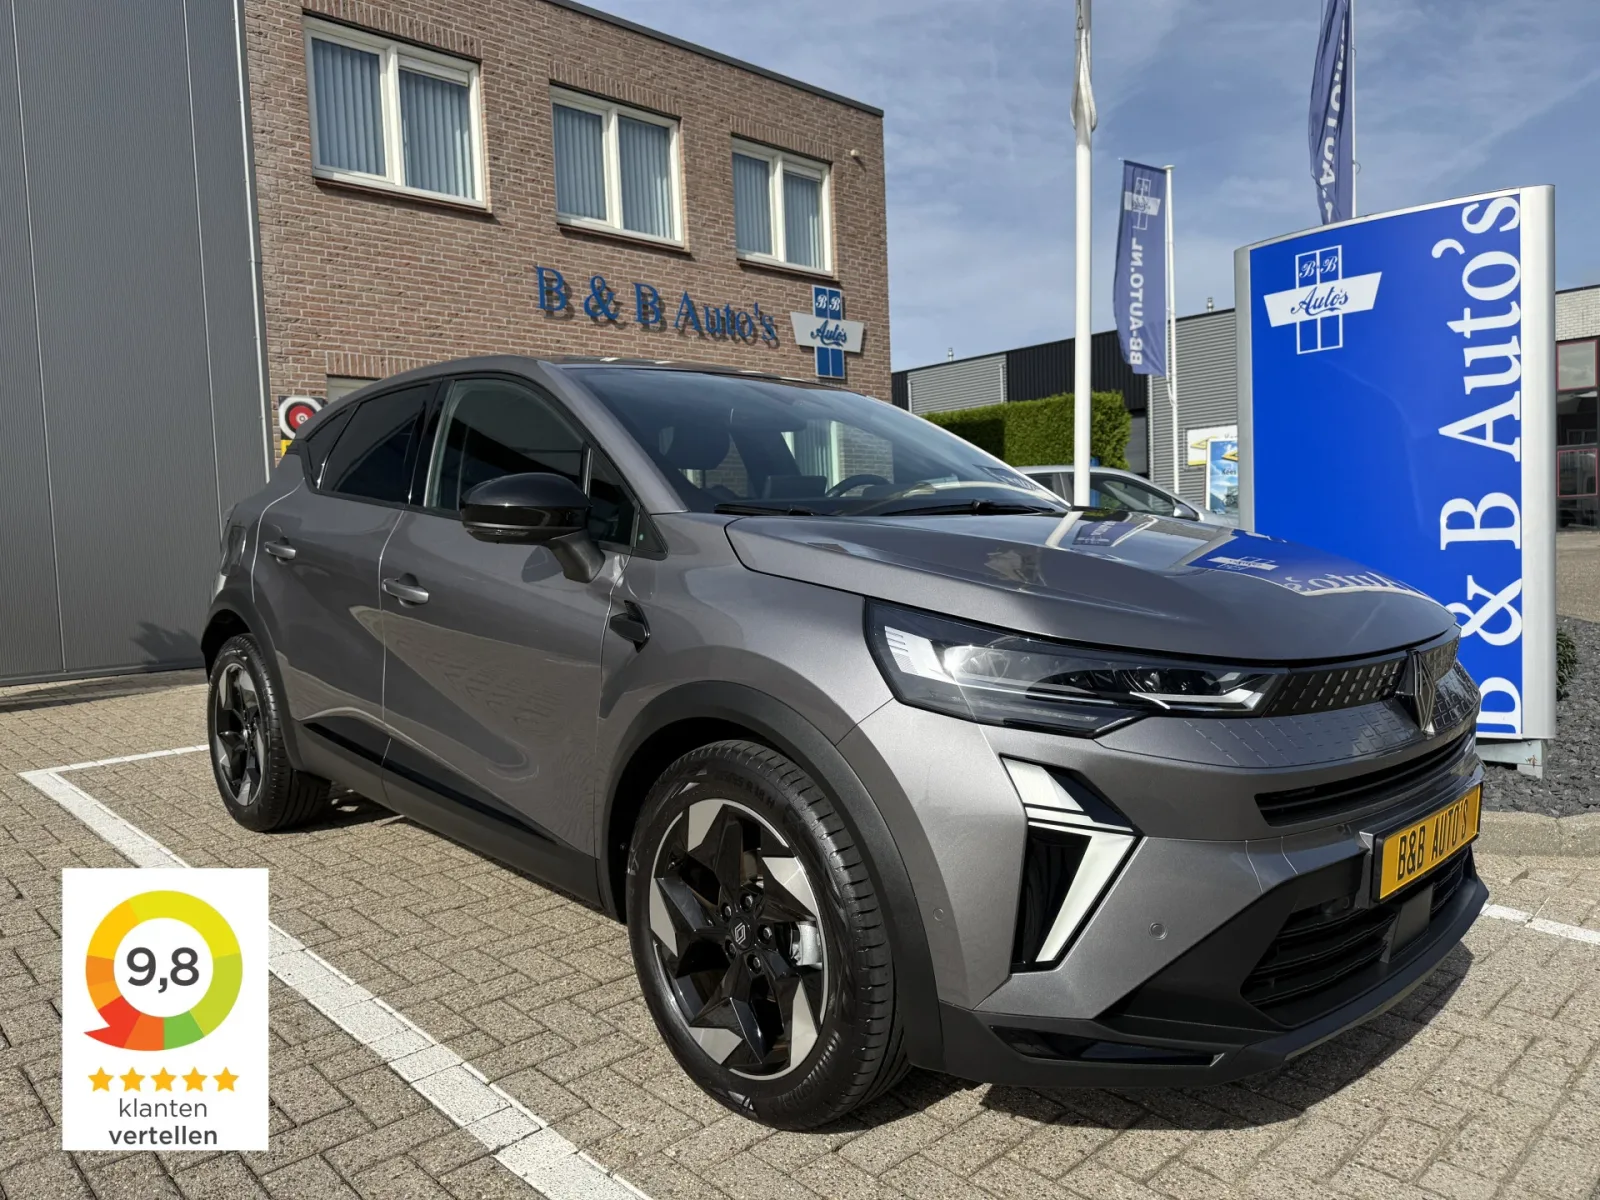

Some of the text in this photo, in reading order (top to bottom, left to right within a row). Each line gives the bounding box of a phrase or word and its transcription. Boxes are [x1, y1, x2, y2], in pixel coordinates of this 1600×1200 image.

[536, 265, 778, 342] B & B Auto's
[810, 319, 847, 347] Auto's
[1291, 286, 1349, 316] Auto's
[1431, 194, 1522, 462] Auto's
[1440, 492, 1521, 551] B
[1444, 575, 1522, 646] &
[1397, 798, 1468, 881] B&B AUTO'S
